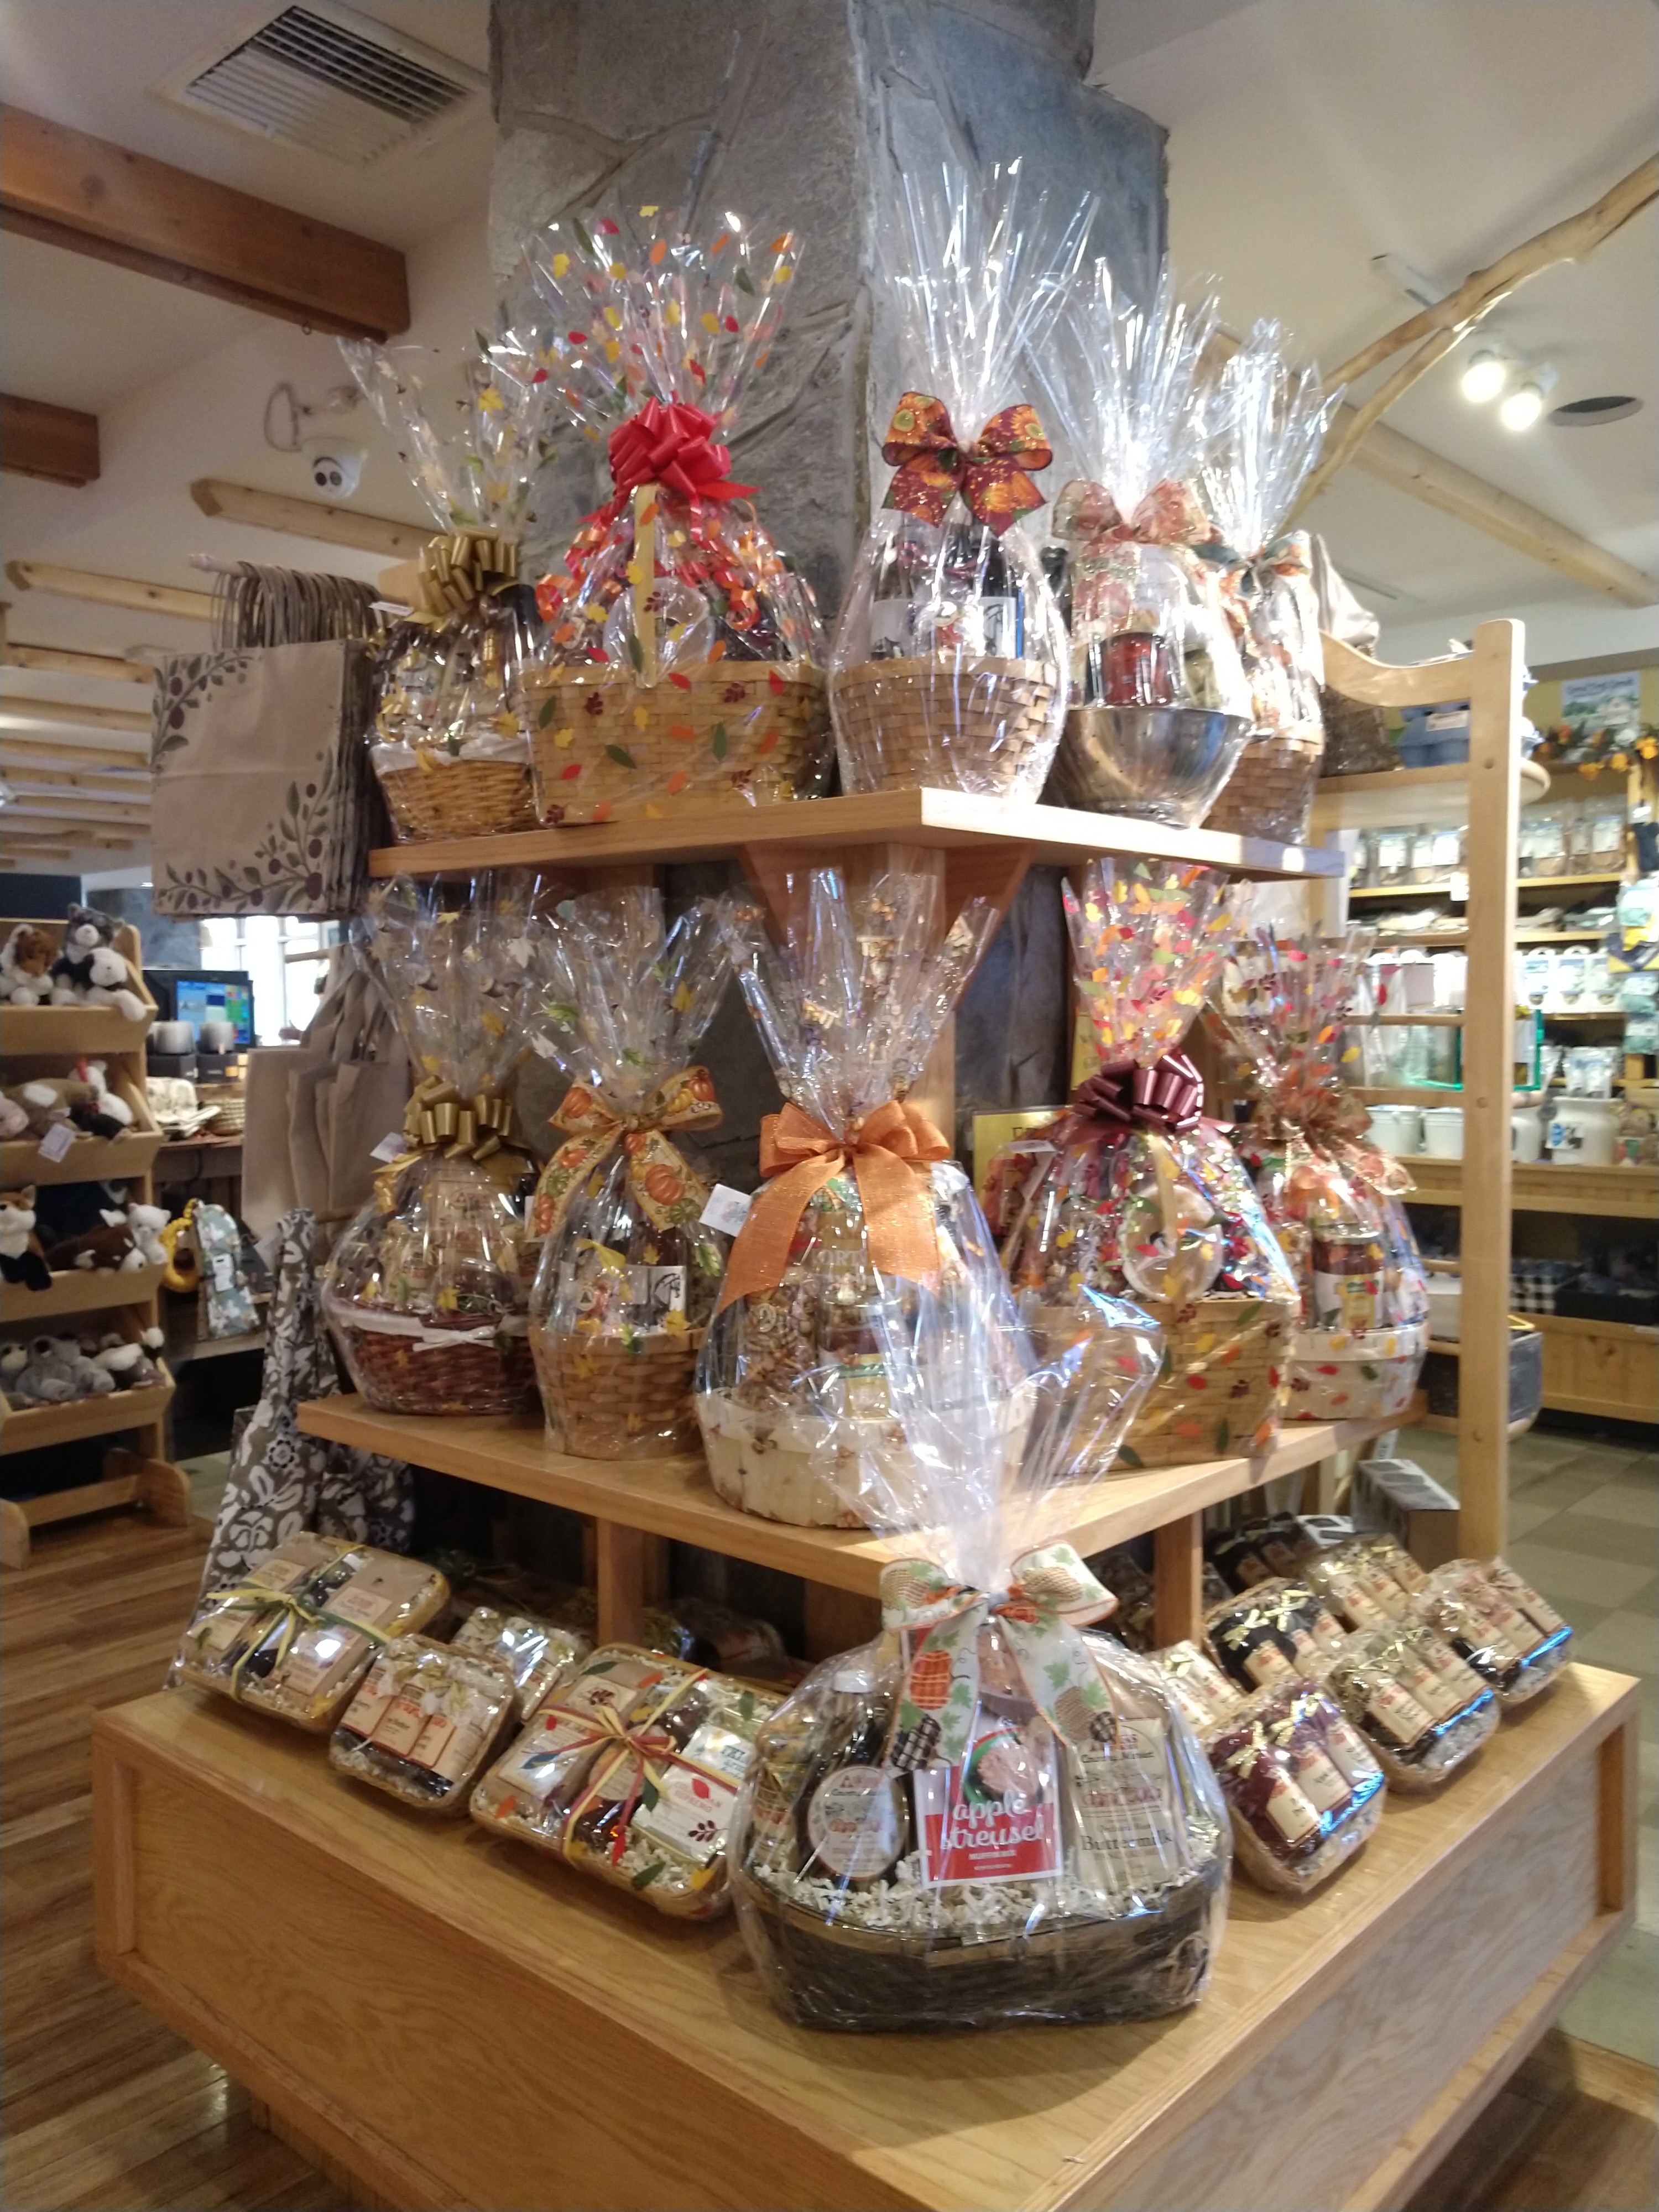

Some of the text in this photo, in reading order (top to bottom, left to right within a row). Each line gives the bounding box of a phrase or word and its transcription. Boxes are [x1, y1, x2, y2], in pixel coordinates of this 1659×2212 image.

[941, 1805, 1045, 1849] streusel
[952, 1789, 1032, 1829] apple
[1081, 1829, 1173, 1850] Buttermilk
